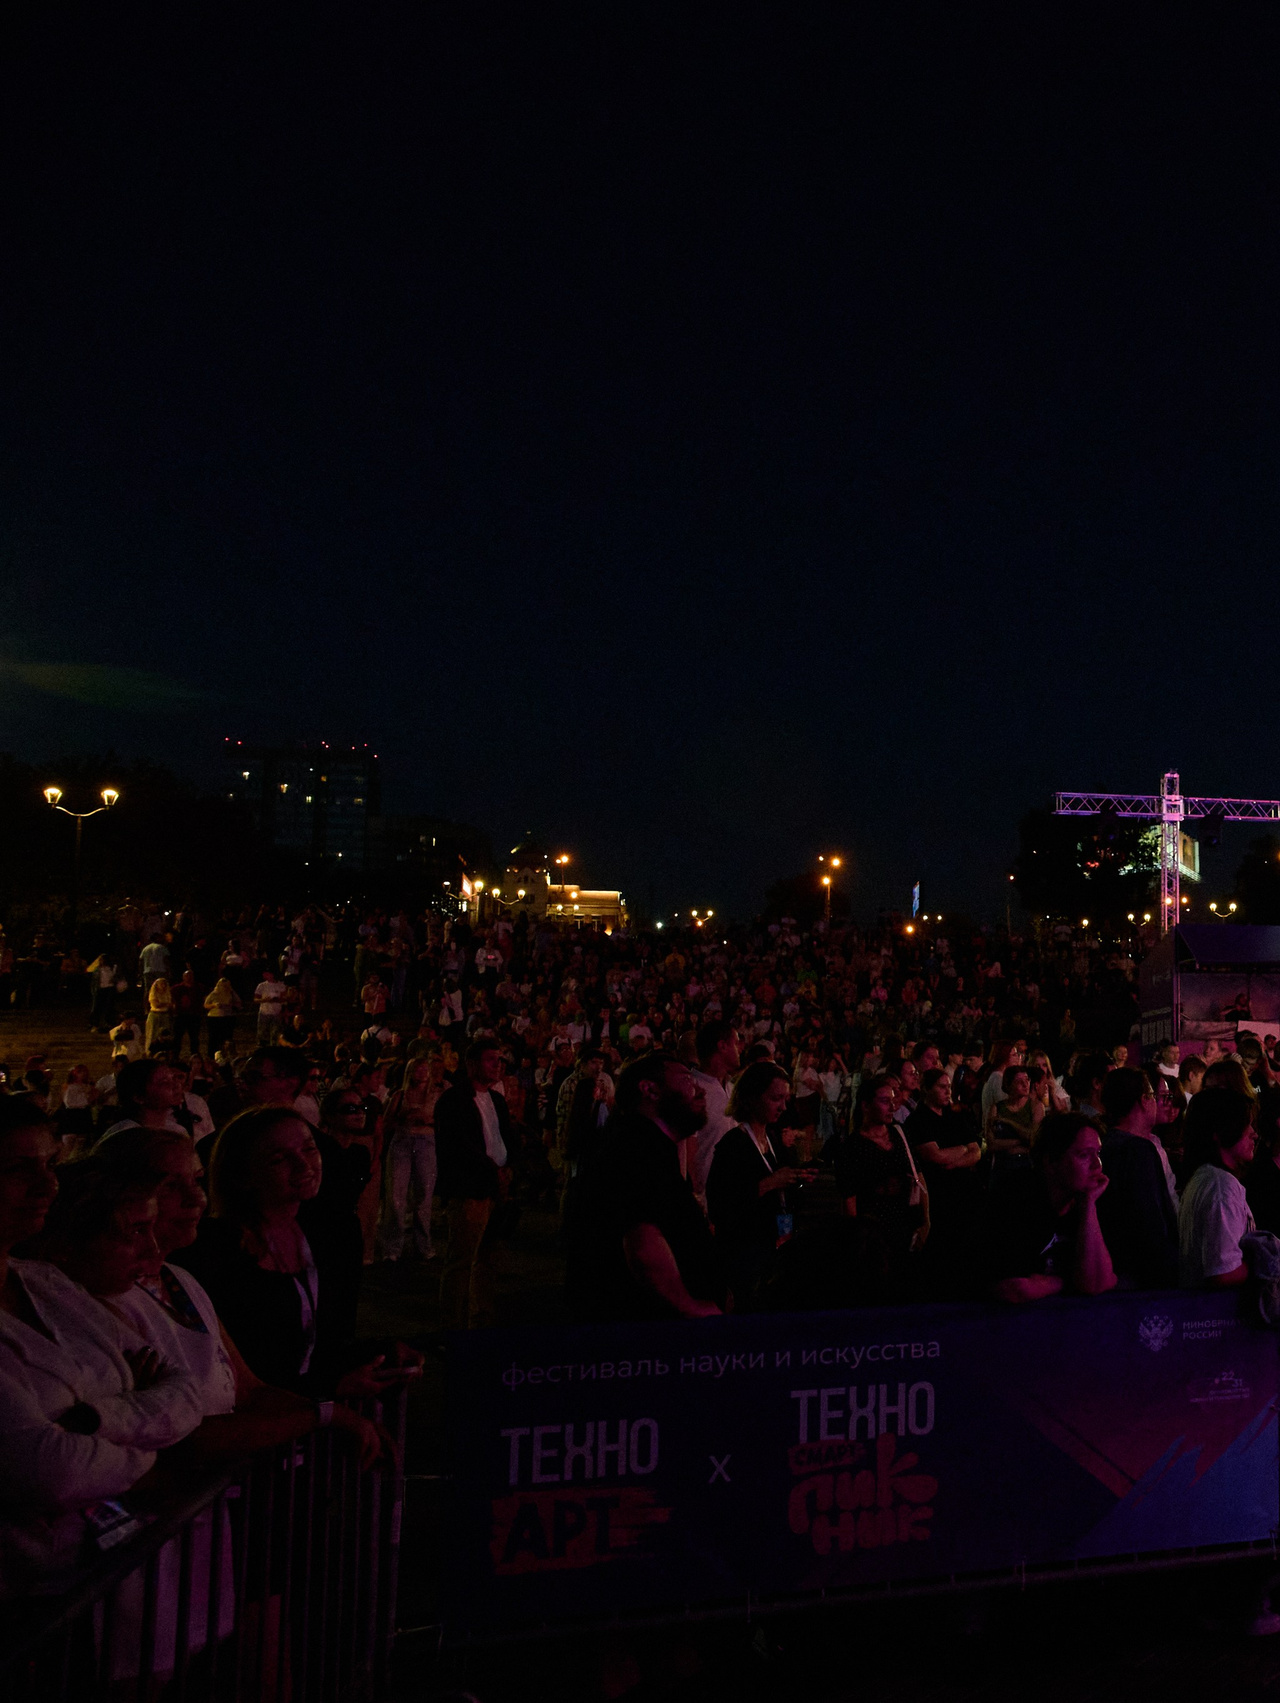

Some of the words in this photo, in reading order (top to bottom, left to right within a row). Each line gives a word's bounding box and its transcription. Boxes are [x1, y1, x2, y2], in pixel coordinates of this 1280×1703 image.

[1182, 1319, 1239, 1331] МИНОБРНА
[1182, 1330, 1222, 1341] РОССИИ
[501, 1361, 670, 1392] фестиваль
[679, 1351, 765, 1378] науки
[775, 1350, 791, 1368] и
[801, 1340, 941, 1370] искусства
[790, 1380, 936, 1444] ТЕХНО
[500, 1416, 660, 1487] ТЕХНО
[501, 1495, 620, 1564] АРТ
